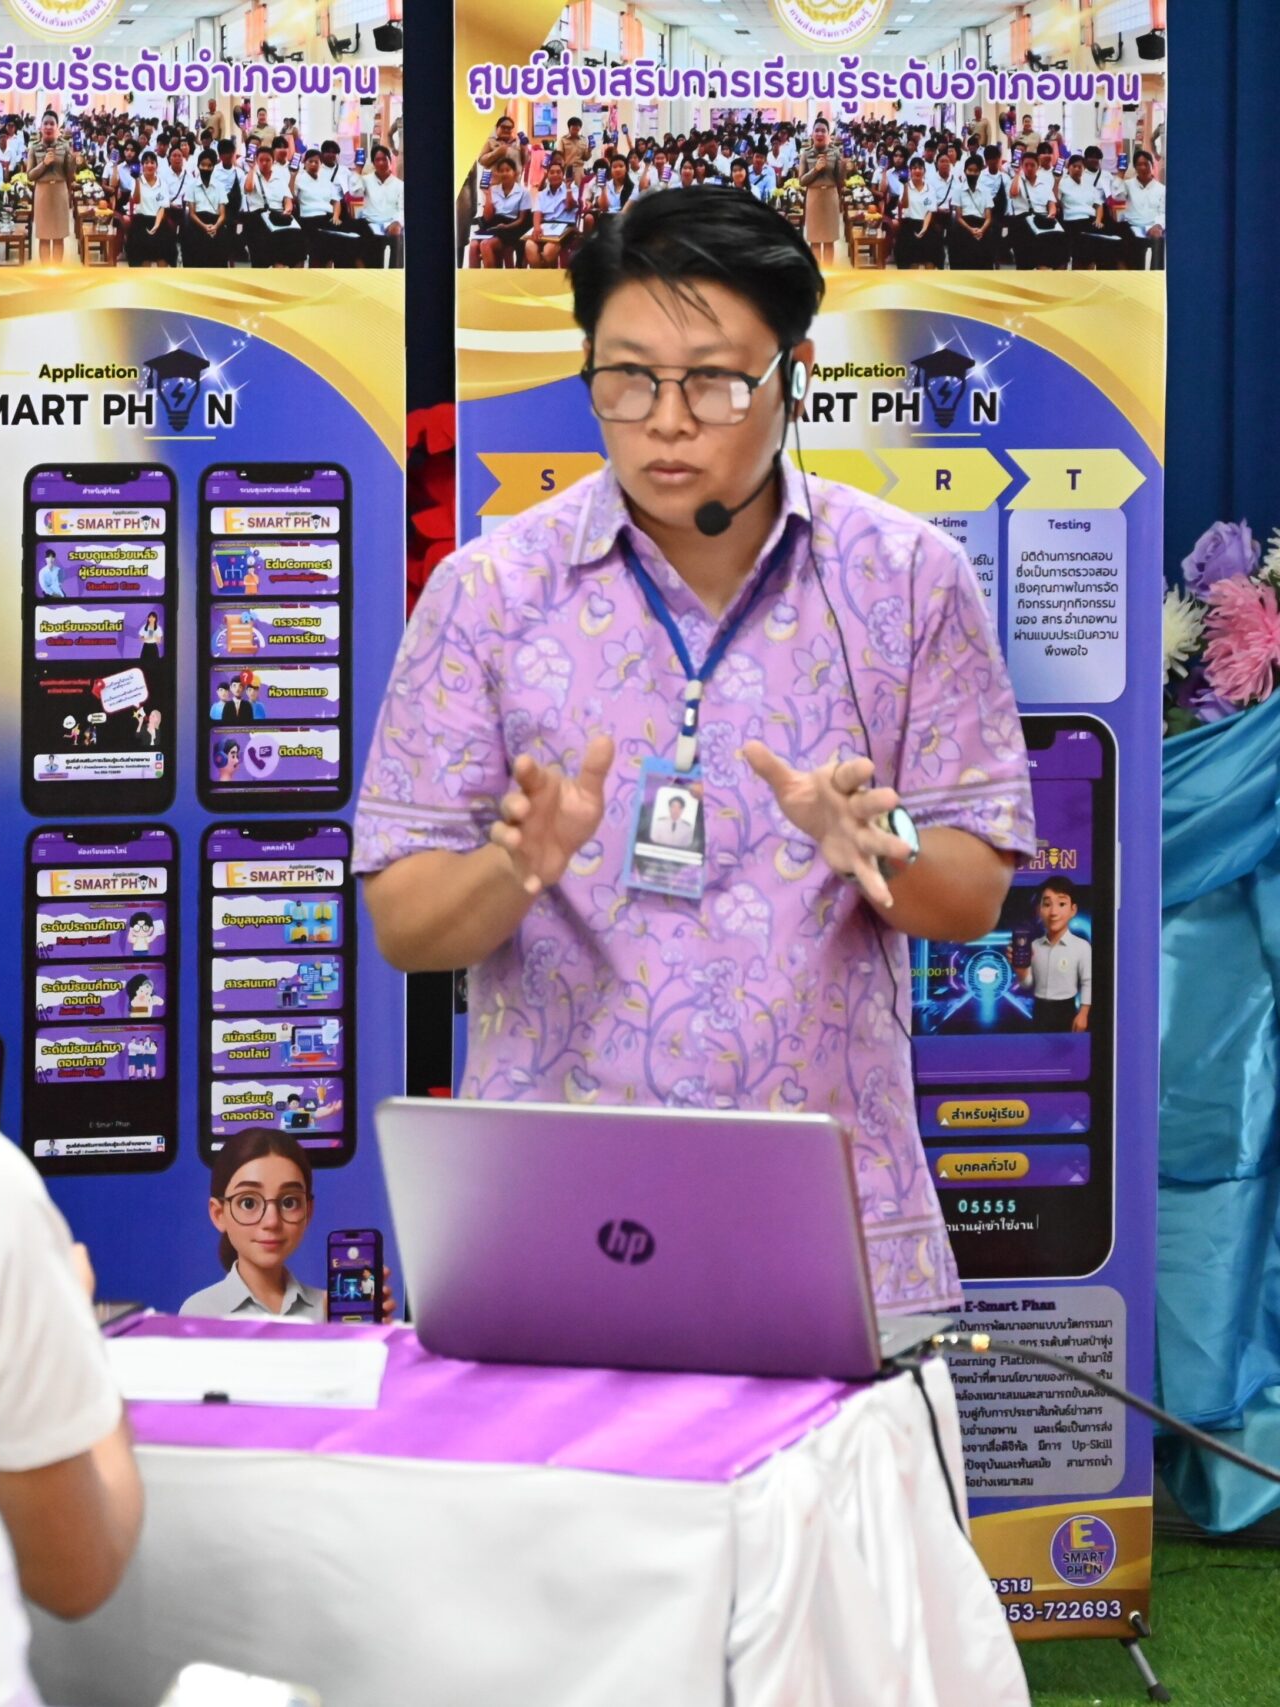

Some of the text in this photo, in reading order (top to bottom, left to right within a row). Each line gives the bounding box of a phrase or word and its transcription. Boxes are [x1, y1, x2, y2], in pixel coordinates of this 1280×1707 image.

[469, 52, 1140, 113] ศูนย์ส่งเสริมการเรียนรู้ระดับอำเภอพาน
[38, 363, 138, 383] Application
[811, 363, 906, 379] Application
[540, 468, 556, 492] S
[935, 469, 952, 491] R
[1066, 468, 1082, 491] T
[76, 518, 121, 530] SMART
[247, 517, 292, 529] SMART
[1048, 519, 1091, 531] Testing
[265, 558, 332, 570] EduConnect
[250, 870, 293, 882] SMART
[74, 878, 118, 890] SMART
[951, 1107, 1024, 1122] สำหรับผู้เรียน
[954, 1156, 1017, 1176] บุคคลทั่วไป
[604, 1219, 651, 1264] hp
[964, 1300, 1019, 1312] E-Smart
[1022, 1299, 1056, 1311] Phan
[949, 1356, 996, 1368] Learning
[1072, 1438, 1112, 1452] Up-Skill
[1071, 1518, 1095, 1549] E
[1062, 1551, 1106, 1564] SMART
